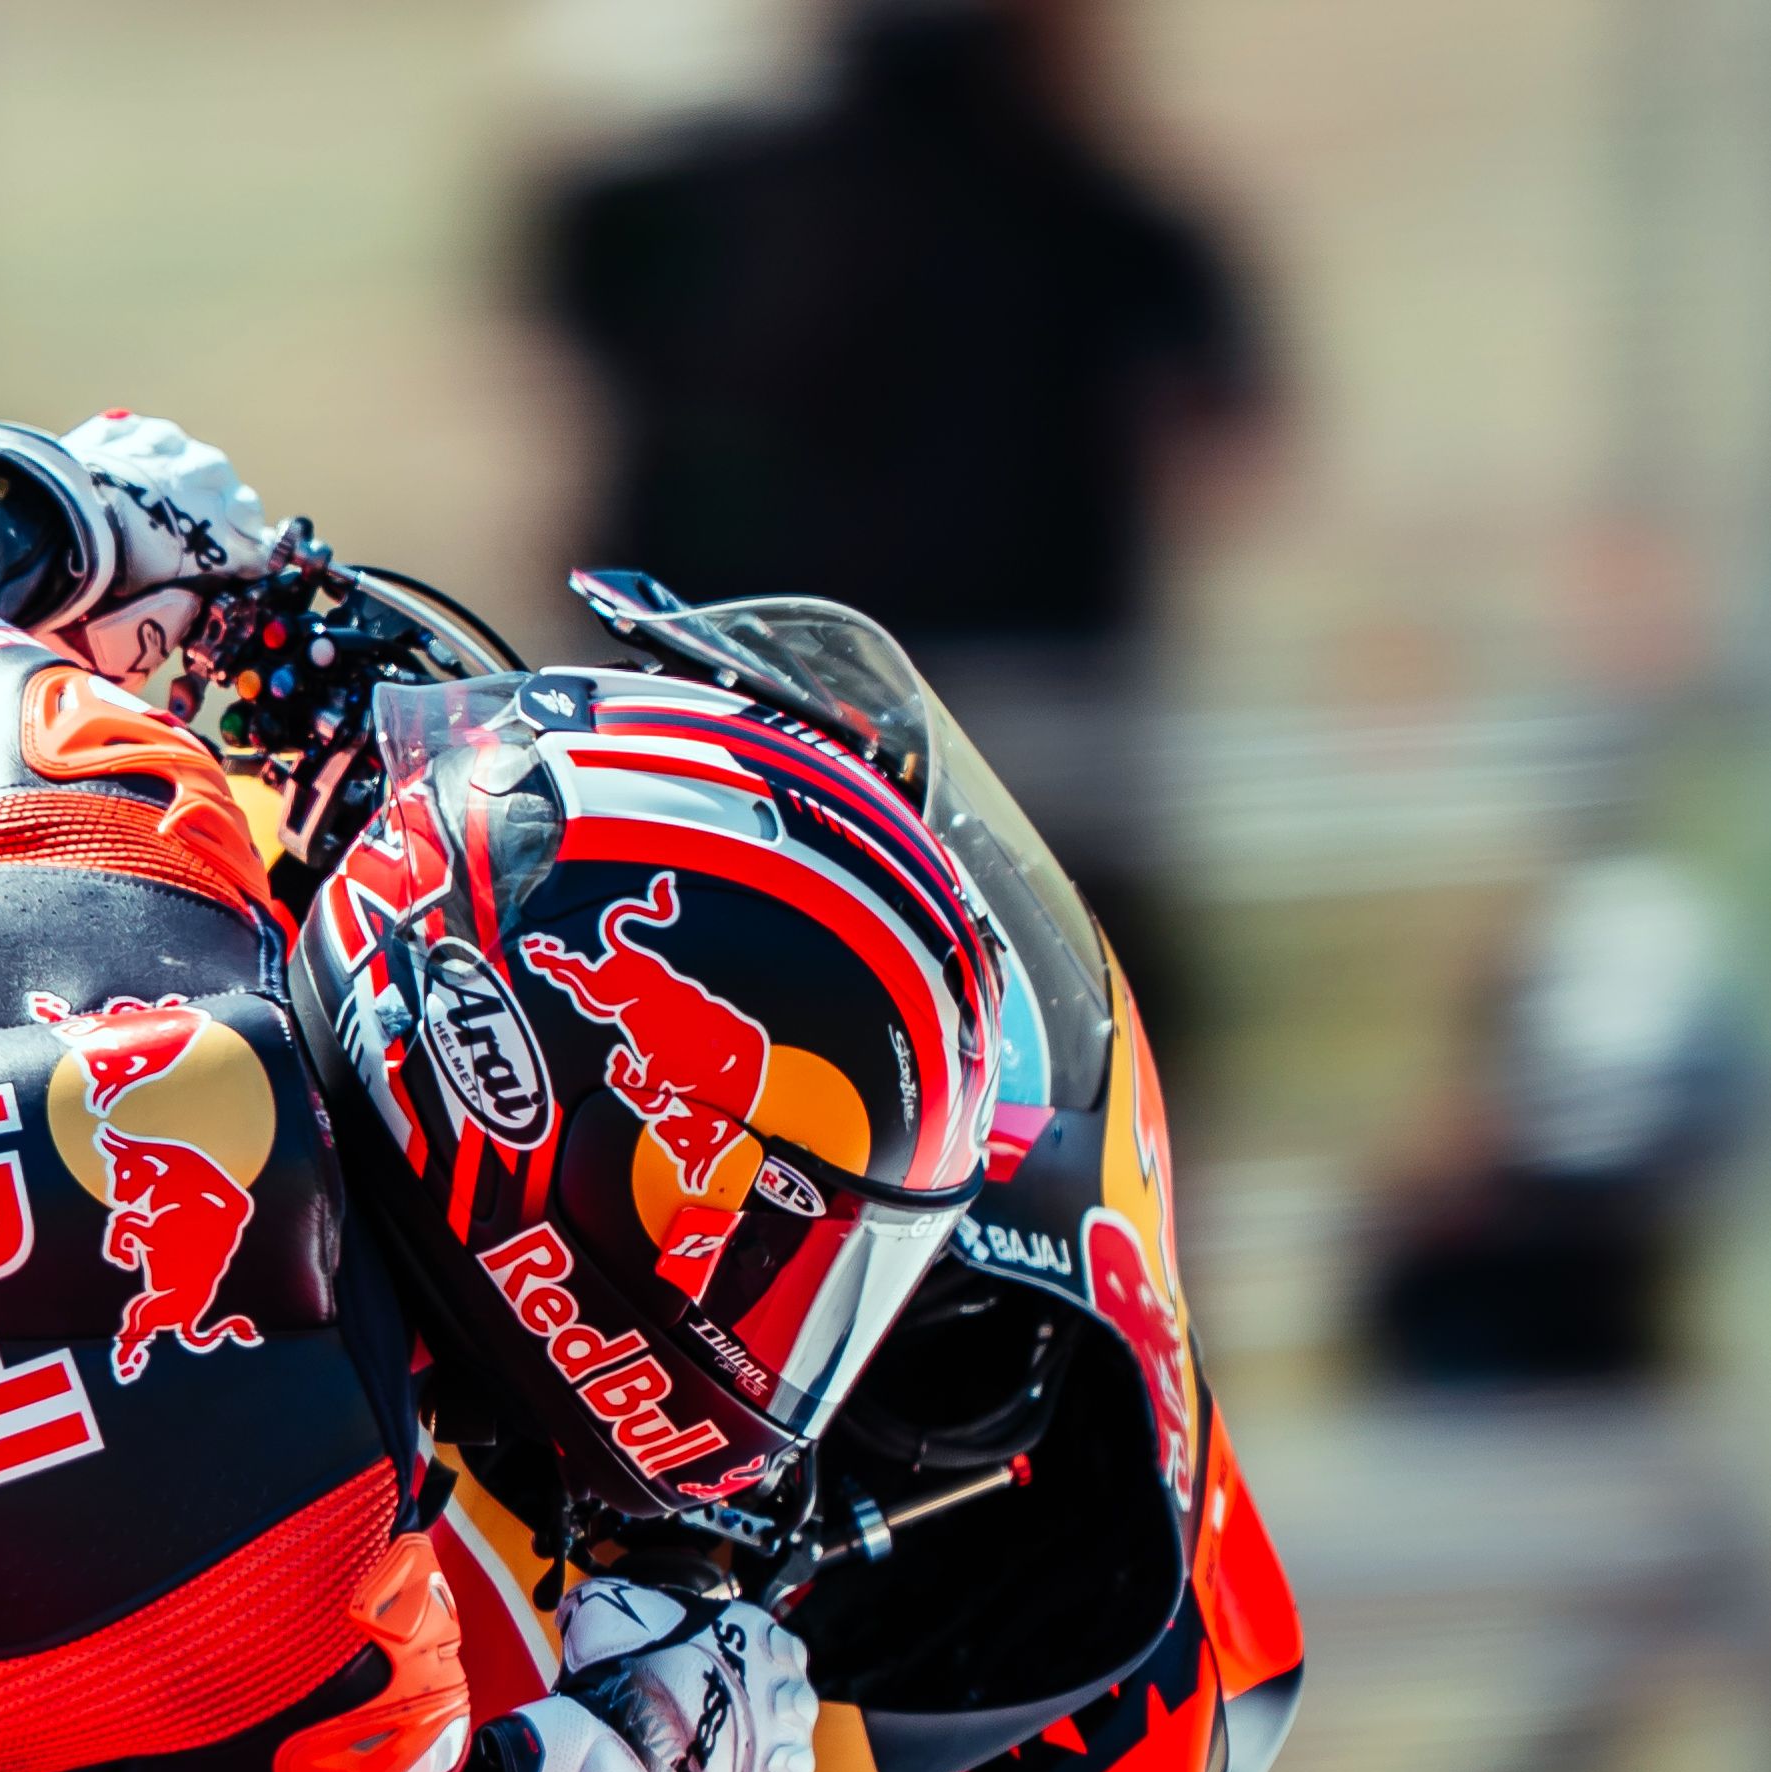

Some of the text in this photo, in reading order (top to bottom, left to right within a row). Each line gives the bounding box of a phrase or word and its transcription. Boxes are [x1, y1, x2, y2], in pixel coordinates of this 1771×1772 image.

[431, 976, 546, 1122] Arai
[475, 1221, 730, 1481] Red Bull
